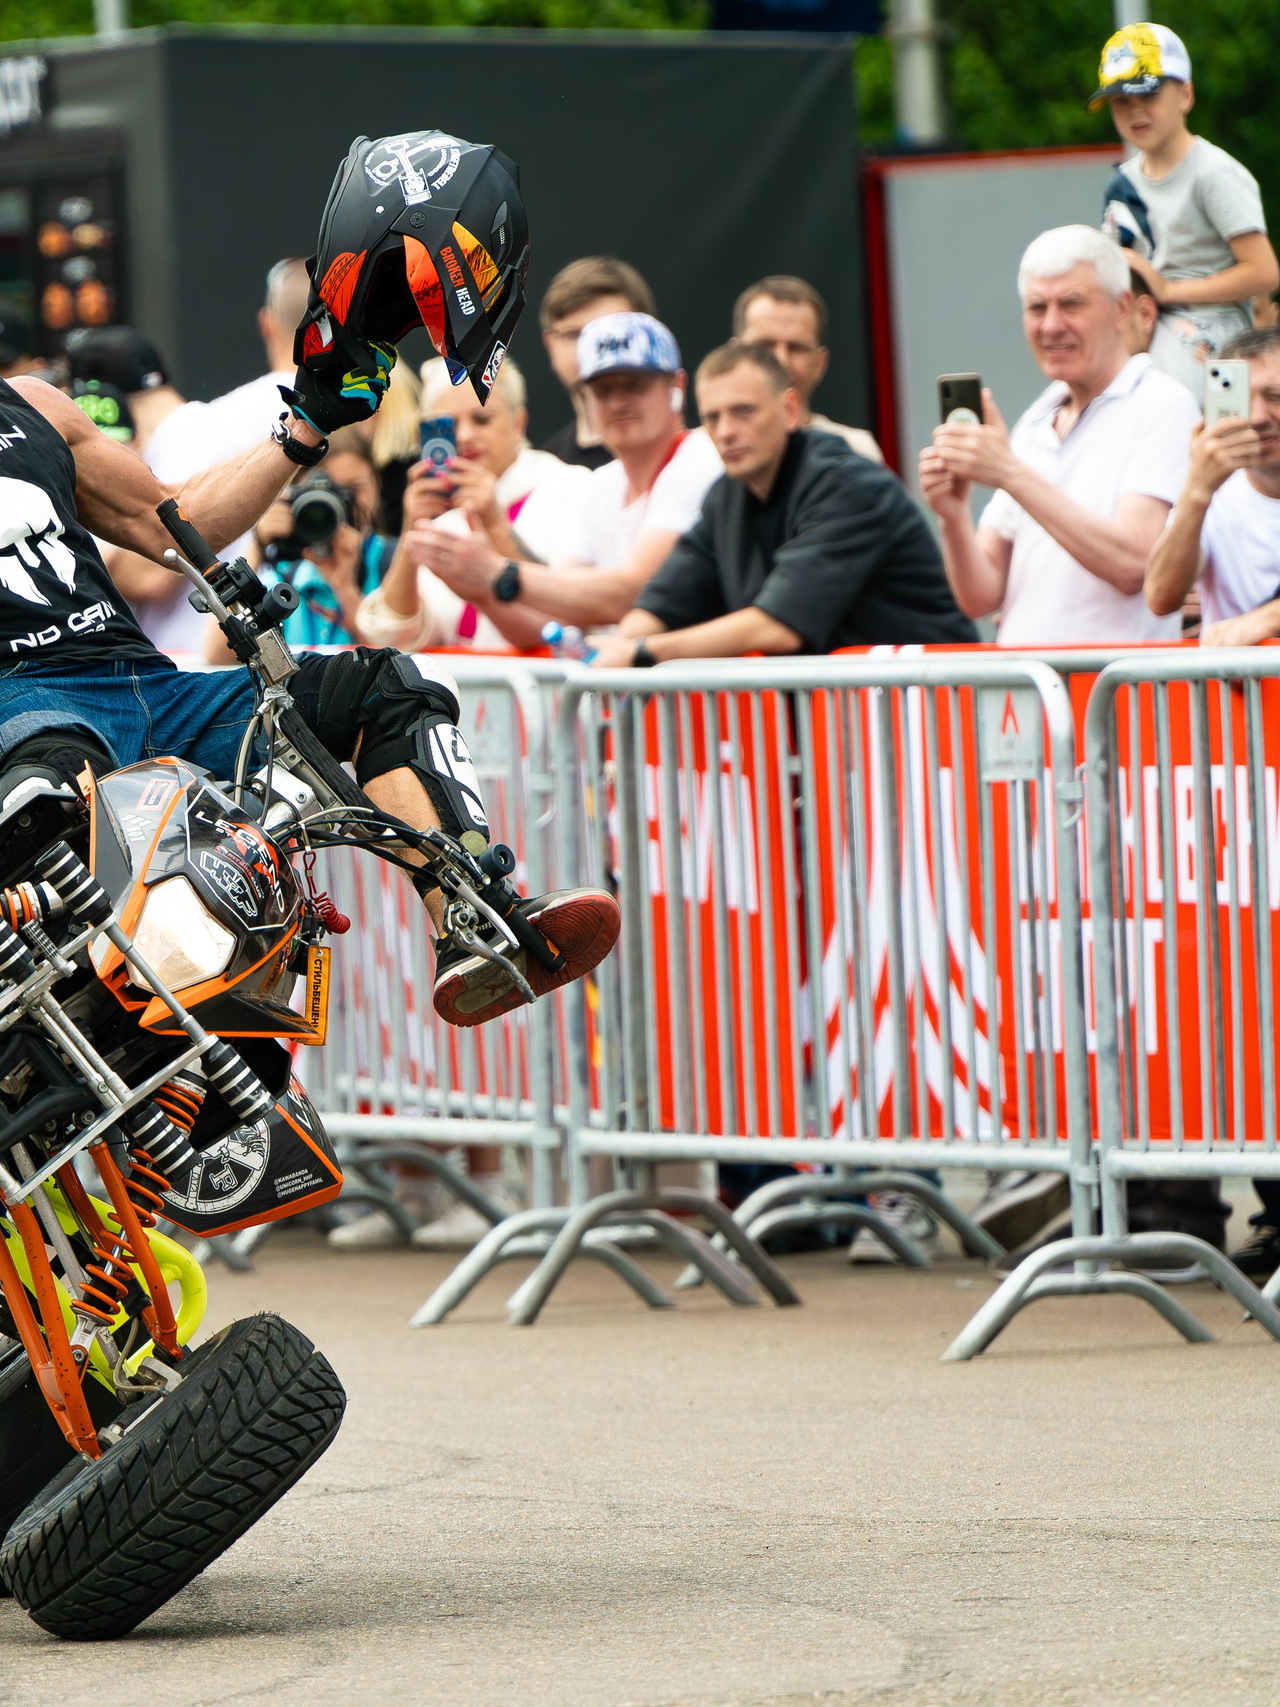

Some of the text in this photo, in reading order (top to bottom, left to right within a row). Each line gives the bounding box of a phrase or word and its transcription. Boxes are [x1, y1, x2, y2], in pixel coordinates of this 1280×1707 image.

[440, 246, 476, 316] BROKEN HEAD
[9, 624, 62, 653] NO
[215, 827, 259, 856] STUNT
[195, 810, 285, 913] LEGEND
[274, 1168, 309, 1186] @KAWABANDA
